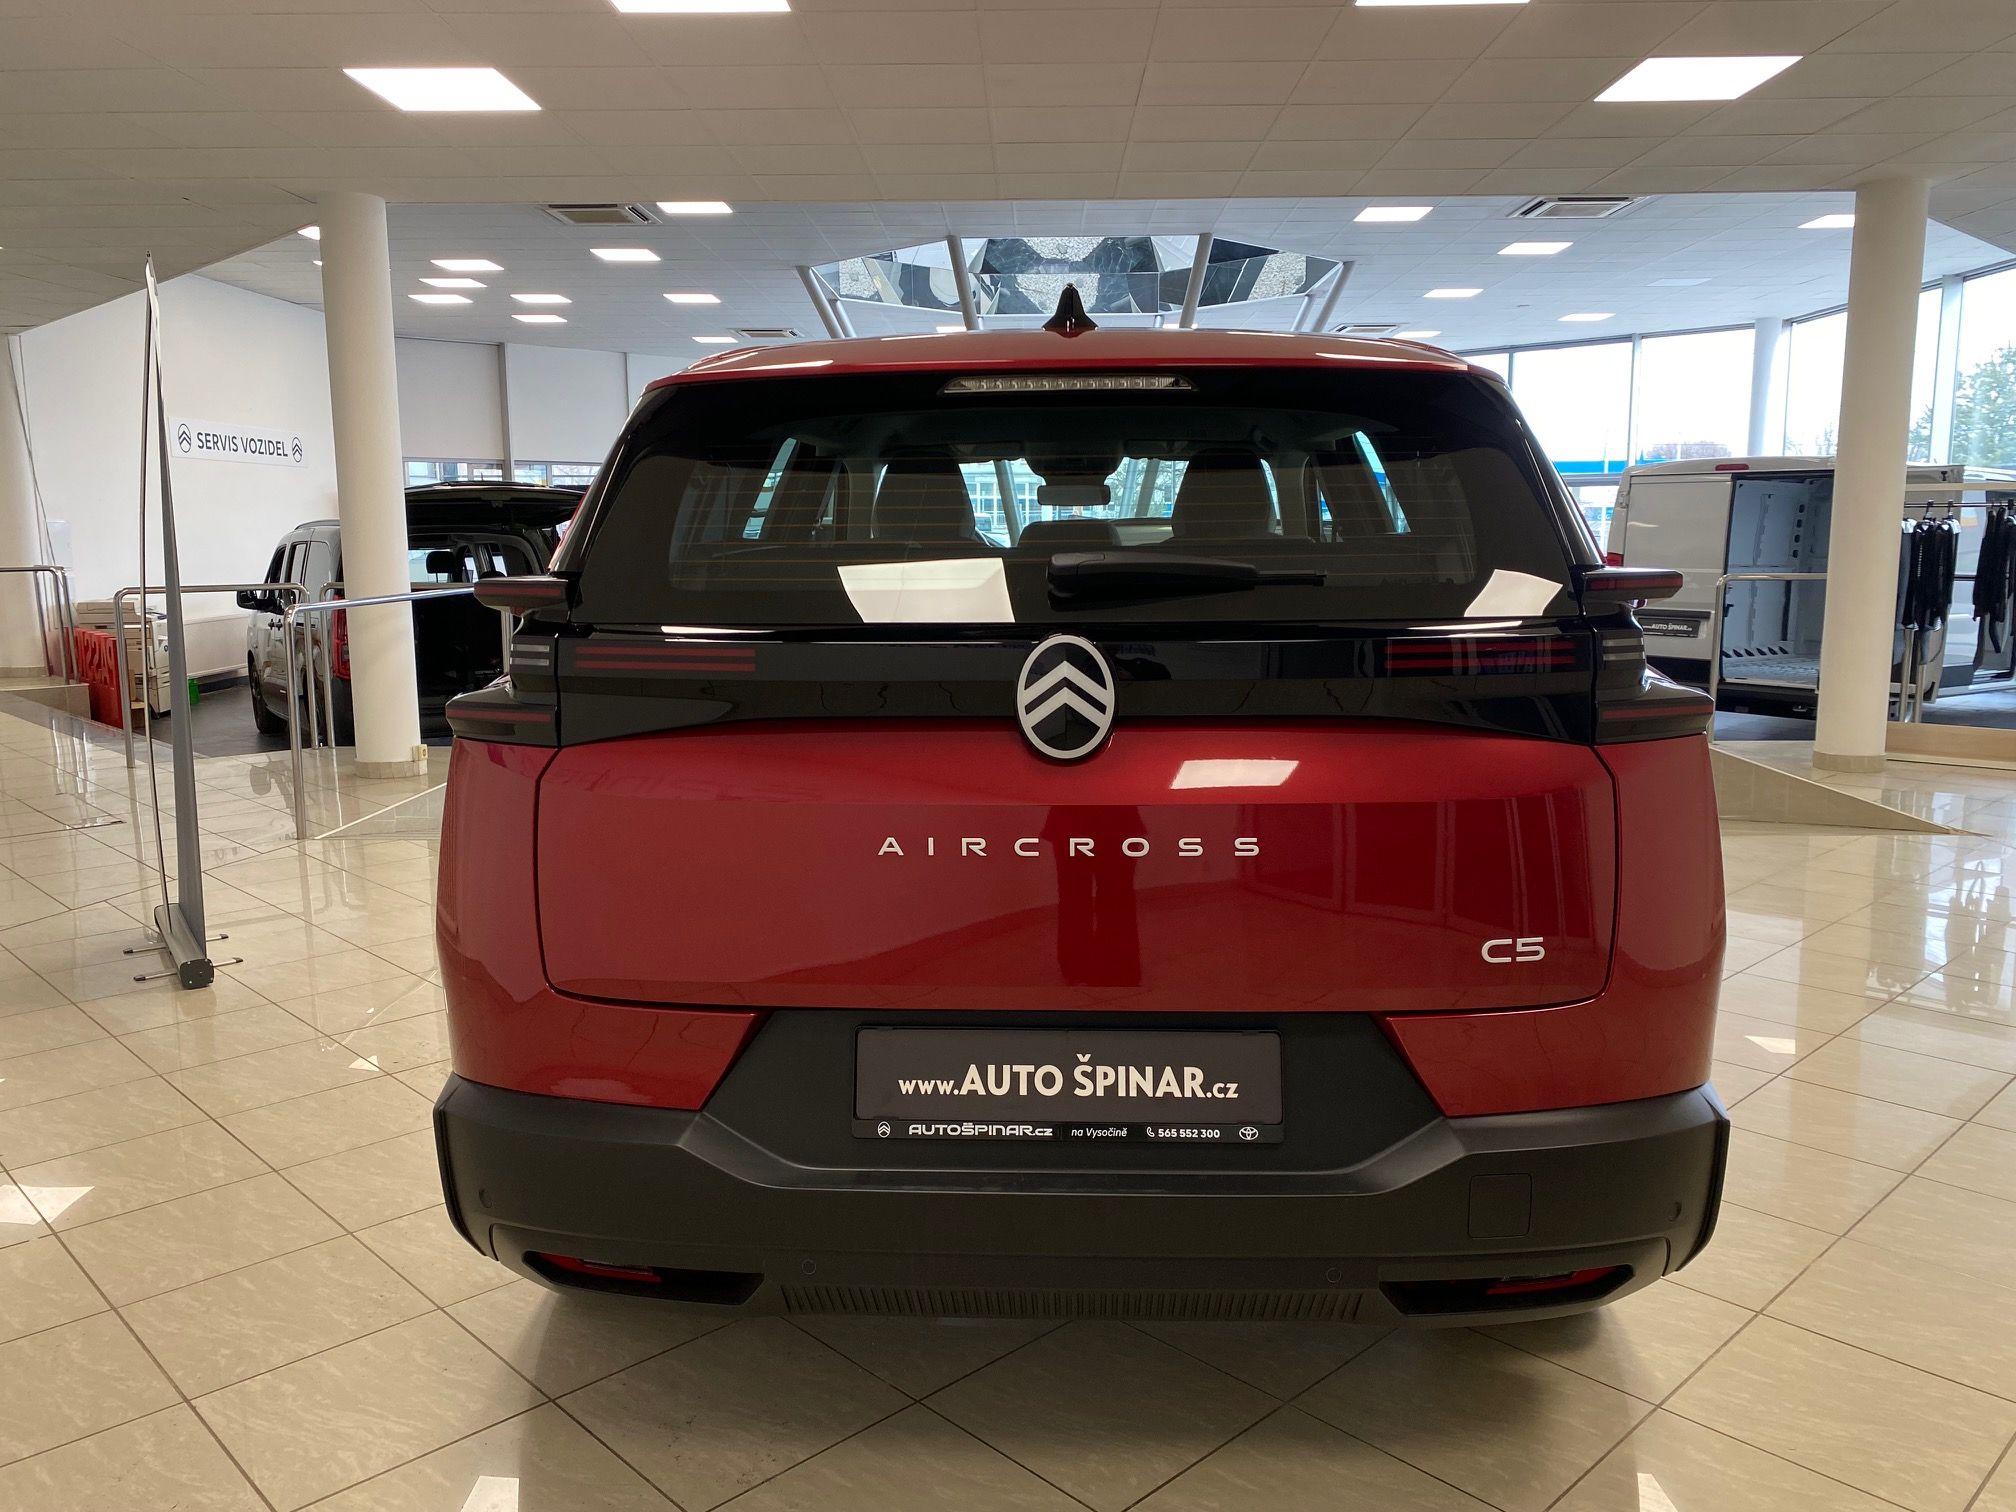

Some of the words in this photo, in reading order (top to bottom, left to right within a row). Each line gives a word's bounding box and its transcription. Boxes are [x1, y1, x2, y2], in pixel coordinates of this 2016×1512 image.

[196, 431, 239, 453] SERVIS
[240, 436, 289, 457] VOZIDEL
[877, 836, 1260, 857] AIRCROSS
[1481, 936, 1546, 964] C5
[898, 1063, 1064, 1097] www.AUTO
[1073, 1053, 1239, 1099] ŠPINAR.cz
[908, 1122, 1053, 1137] AUTOŠPINAR.cz
[1071, 1129, 1084, 1138] na
[1085, 1126, 1128, 1139] Vysočině
[1157, 1128, 1178, 1138] 565
[1179, 1128, 1199, 1138] 552
[1200, 1128, 1221, 1139] 300
